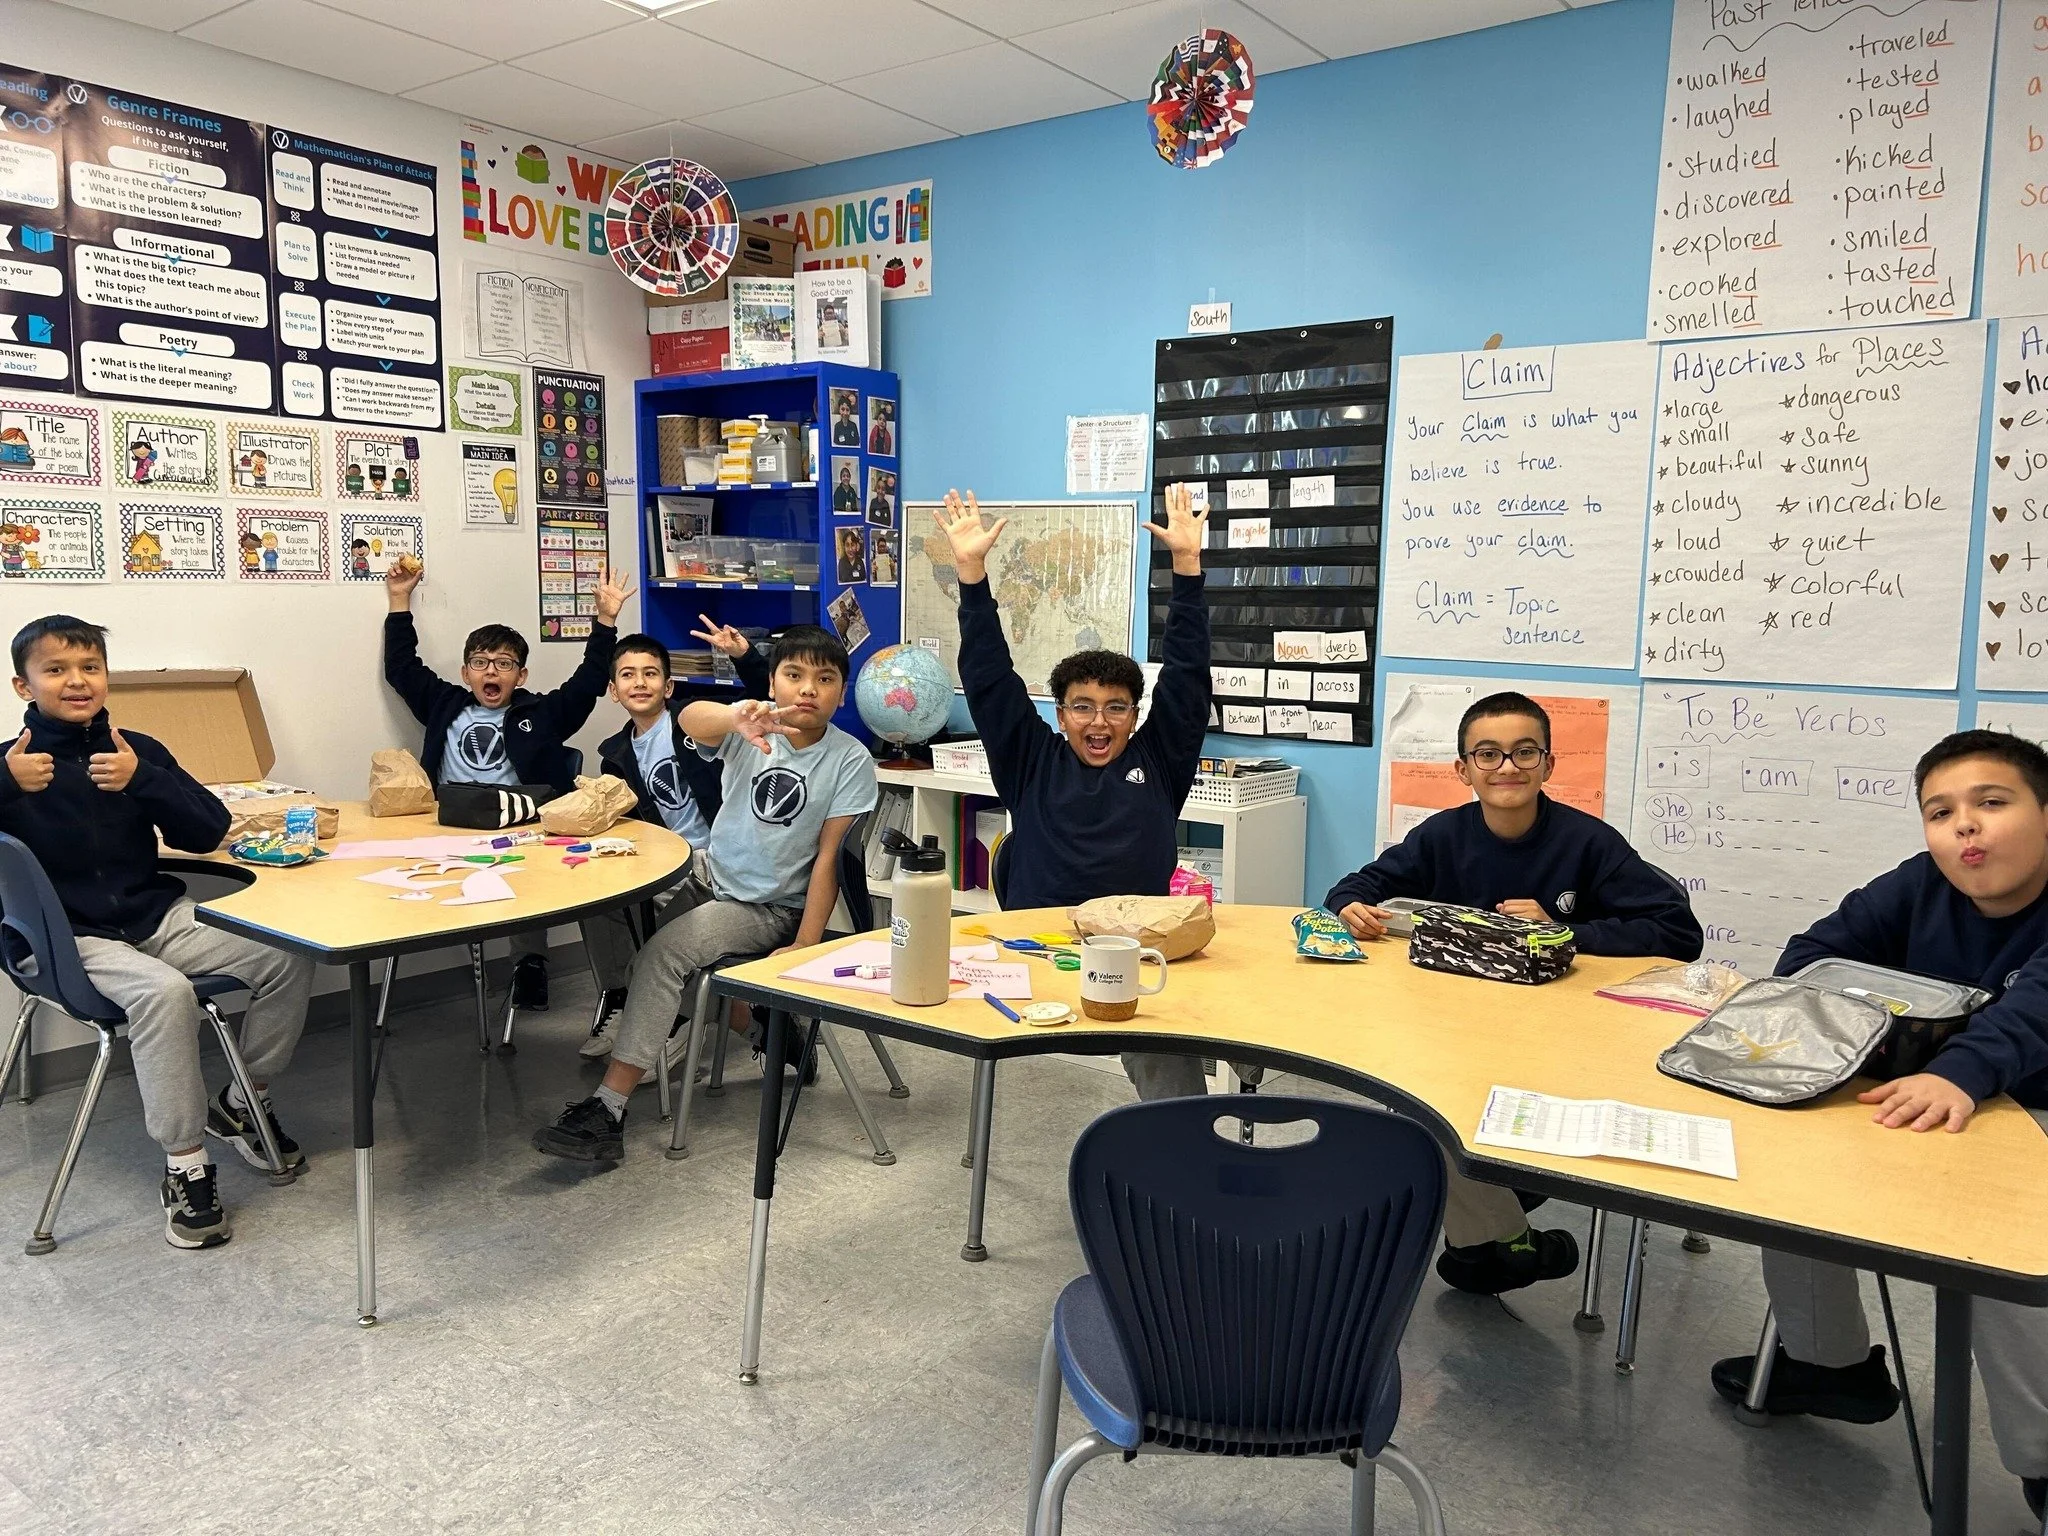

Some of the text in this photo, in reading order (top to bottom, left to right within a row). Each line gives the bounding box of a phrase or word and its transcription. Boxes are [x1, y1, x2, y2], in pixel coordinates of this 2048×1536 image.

[1711, 0, 1771, 29] Past
[1853, 19, 1949, 59] traveled
[1687, 57, 1766, 92] walked
[1857, 64, 1939, 91] tested
[108, 95, 222, 133] Genre Frames
[1687, 89, 1770, 138] laughed
[1850, 89, 1929, 134] played
[102, 116, 229, 152] Questions to ask yourself,
[132, 136, 202, 159] if the genre is:
[1679, 137, 1776, 179] studied
[1846, 133, 1933, 174] kicked
[148, 159, 189, 176] Fiction
[294, 139, 433, 180] Mathematician's Plan of Attack
[275, 169, 311, 183] Read and
[283, 182, 305, 193] Think
[1675, 179, 1790, 220] discovered
[1845, 167, 1945, 219] painted
[489, 187, 580, 251] LOVE
[1673, 220, 1777, 266] explored
[1843, 214, 1928, 252] smiled
[130, 236, 215, 259] Informational
[284, 240, 310, 251] Plan to
[93, 252, 196, 277] What is the big topic?
[288, 252, 308, 263] Solve
[1844, 249, 1936, 284] tasted
[487, 275, 513, 288] FICTION
[525, 282, 564, 297] NONFICTION
[830, 288, 853, 296] Citizen
[1669, 268, 1757, 301] cooked
[1840, 277, 1955, 321] touched
[286, 310, 316, 321] Execute
[1191, 310, 1228, 327] South
[1664, 295, 1755, 334] smelled
[285, 321, 317, 332] the Plan
[160, 334, 198, 350] Poetry
[1467, 358, 1544, 390] Claim
[1673, 337, 1944, 394] Adjectives for Places
[292, 380, 315, 389] Check
[293, 390, 314, 400] Work
[471, 381, 499, 391] Main Idea
[538, 375, 600, 392] PUNCTUATION
[476, 402, 496, 411] Details
[1798, 384, 1901, 419] dangerous
[25, 416, 66, 433] Title
[1103, 420, 1132, 428] Structures
[1408, 407, 1637, 440] Your Claim is what you
[1674, 399, 1723, 429] large
[137, 427, 198, 445] Author
[242, 434, 309, 450] Illustrator
[1678, 422, 1729, 445] small
[1801, 421, 1861, 447] safe
[365, 443, 392, 457] Plot
[470, 451, 508, 461] MAIN IDEA
[1411, 451, 1562, 481] believe is true.
[1676, 450, 1763, 476] beautiful
[1801, 455, 1870, 487] sunny
[1231, 483, 1255, 498] inch
[1292, 482, 1325, 500] length
[1808, 486, 1947, 512] incredible
[541, 510, 566, 519] PARTS
[575, 510, 606, 521] SPEECH
[1402, 495, 1602, 521] You use evidence to
[1671, 490, 1742, 522] cloudy
[6, 512, 88, 526] Characters
[144, 516, 204, 535] Setting
[261, 520, 309, 532] Problem
[364, 526, 404, 536] Solution
[1677, 527, 1721, 551] loud
[1406, 529, 1573, 559] prove your claim.
[1801, 527, 1875, 566] quiet
[1664, 559, 1744, 583] crowded
[1791, 569, 1904, 599] colorful
[1416, 581, 1559, 625] Claim Topic
[1667, 605, 1725, 625] clean
[1790, 603, 1833, 628] red
[1277, 643, 1309, 656] Noun
[1664, 638, 1725, 672] dirty
[1231, 675, 1247, 687] on
[1278, 677, 1289, 690] in
[1316, 682, 1355, 692] across
[1228, 709, 1260, 724] between
[1270, 707, 1303, 717] in front
[1280, 717, 1292, 728] of
[1312, 720, 1337, 731] near
[1672, 750, 1897, 797] is am are
[1651, 799, 1725, 821] She is
[1664, 824, 1724, 848] He is
[1706, 924, 1740, 943] are
